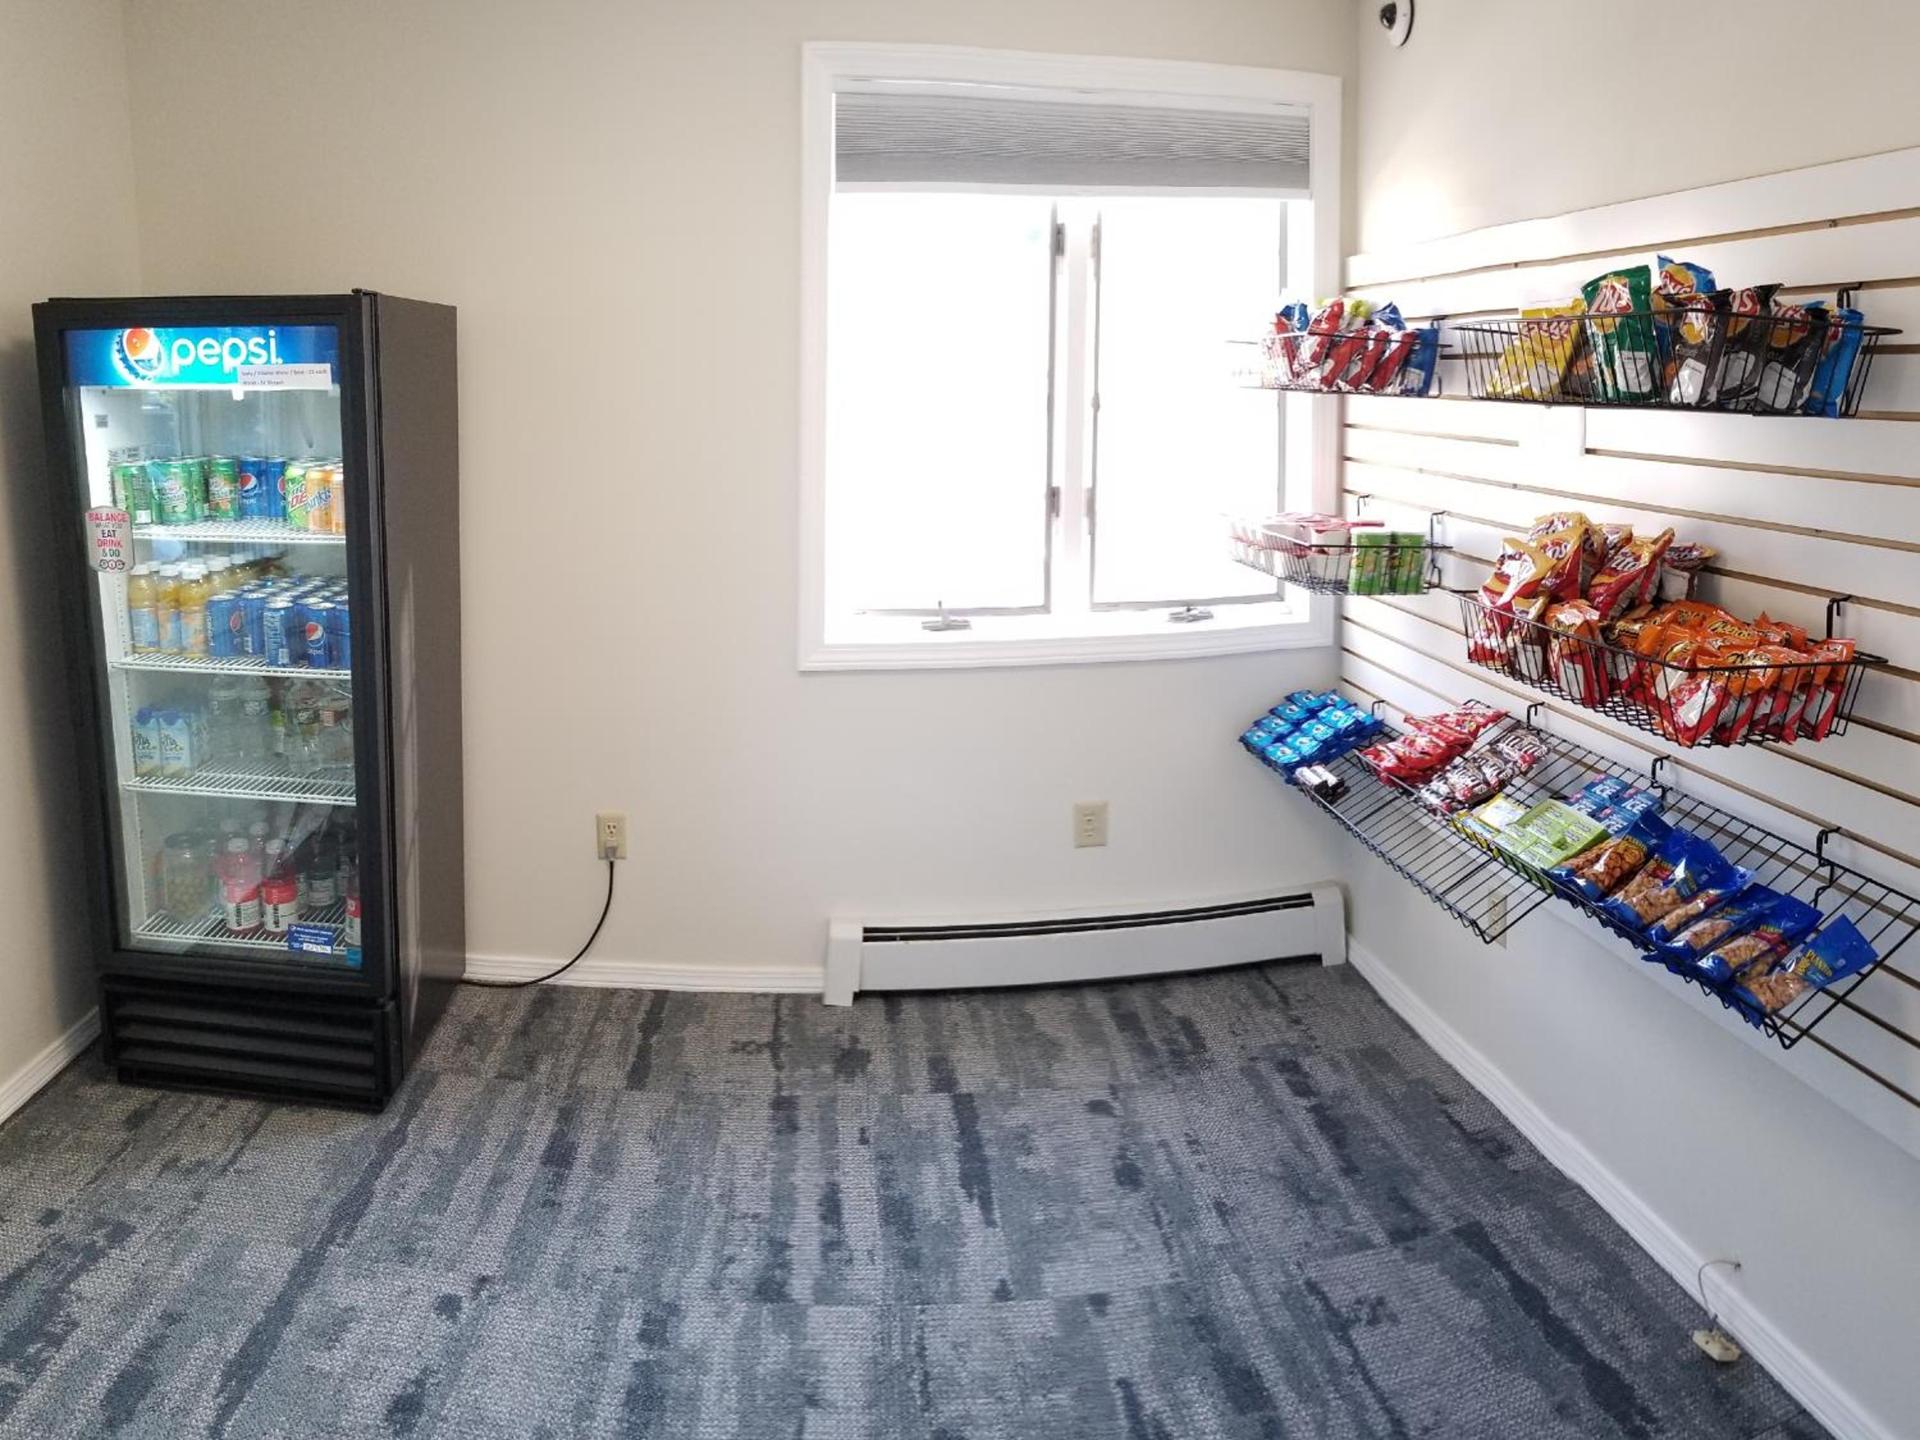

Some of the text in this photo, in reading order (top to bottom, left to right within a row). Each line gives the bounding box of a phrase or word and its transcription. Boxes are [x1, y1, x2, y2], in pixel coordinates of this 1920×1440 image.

[171, 329, 277, 375] pepsi
[88, 511, 129, 523] BALANCE
[101, 529, 117, 539] EAT
[96, 538, 123, 549] DRINK
[109, 549, 120, 558] DO
[1591, 784, 1621, 799] ICE
[1621, 798, 1652, 814] ICE
